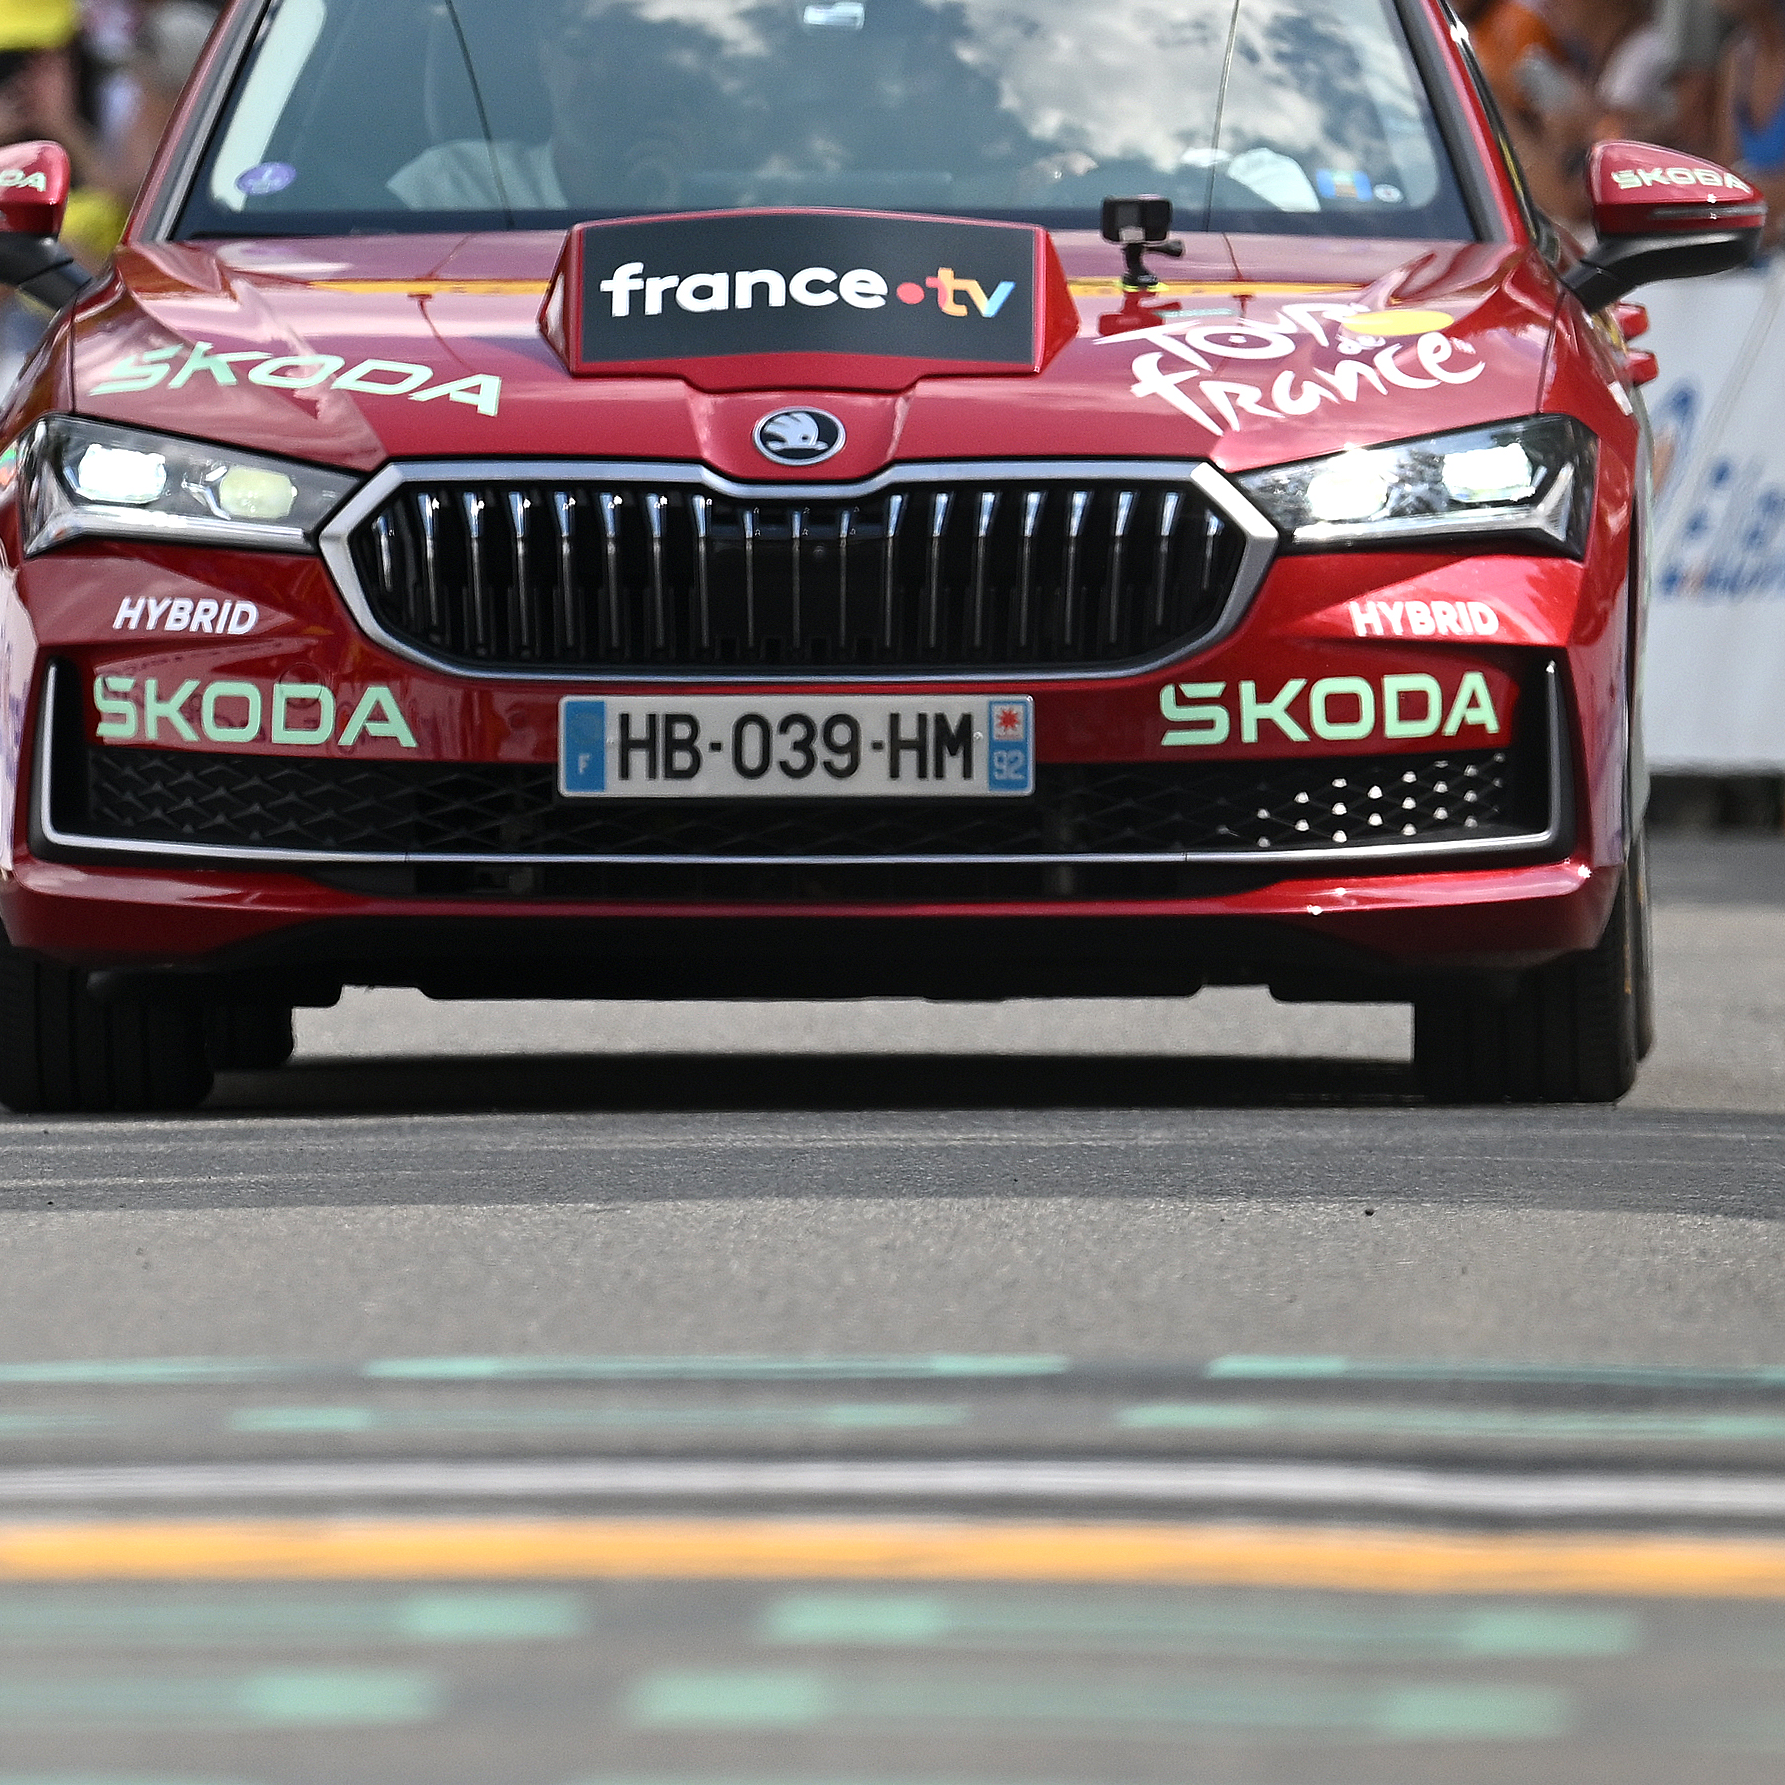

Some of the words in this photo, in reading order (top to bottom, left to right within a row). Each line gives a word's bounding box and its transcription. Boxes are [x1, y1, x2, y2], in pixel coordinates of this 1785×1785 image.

[113, 596, 259, 636] HYBRID
[1349, 600, 1501, 639] HYBRID
[618, 712, 976, 781] HB-039-HM
[993, 749, 1026, 782] 92
